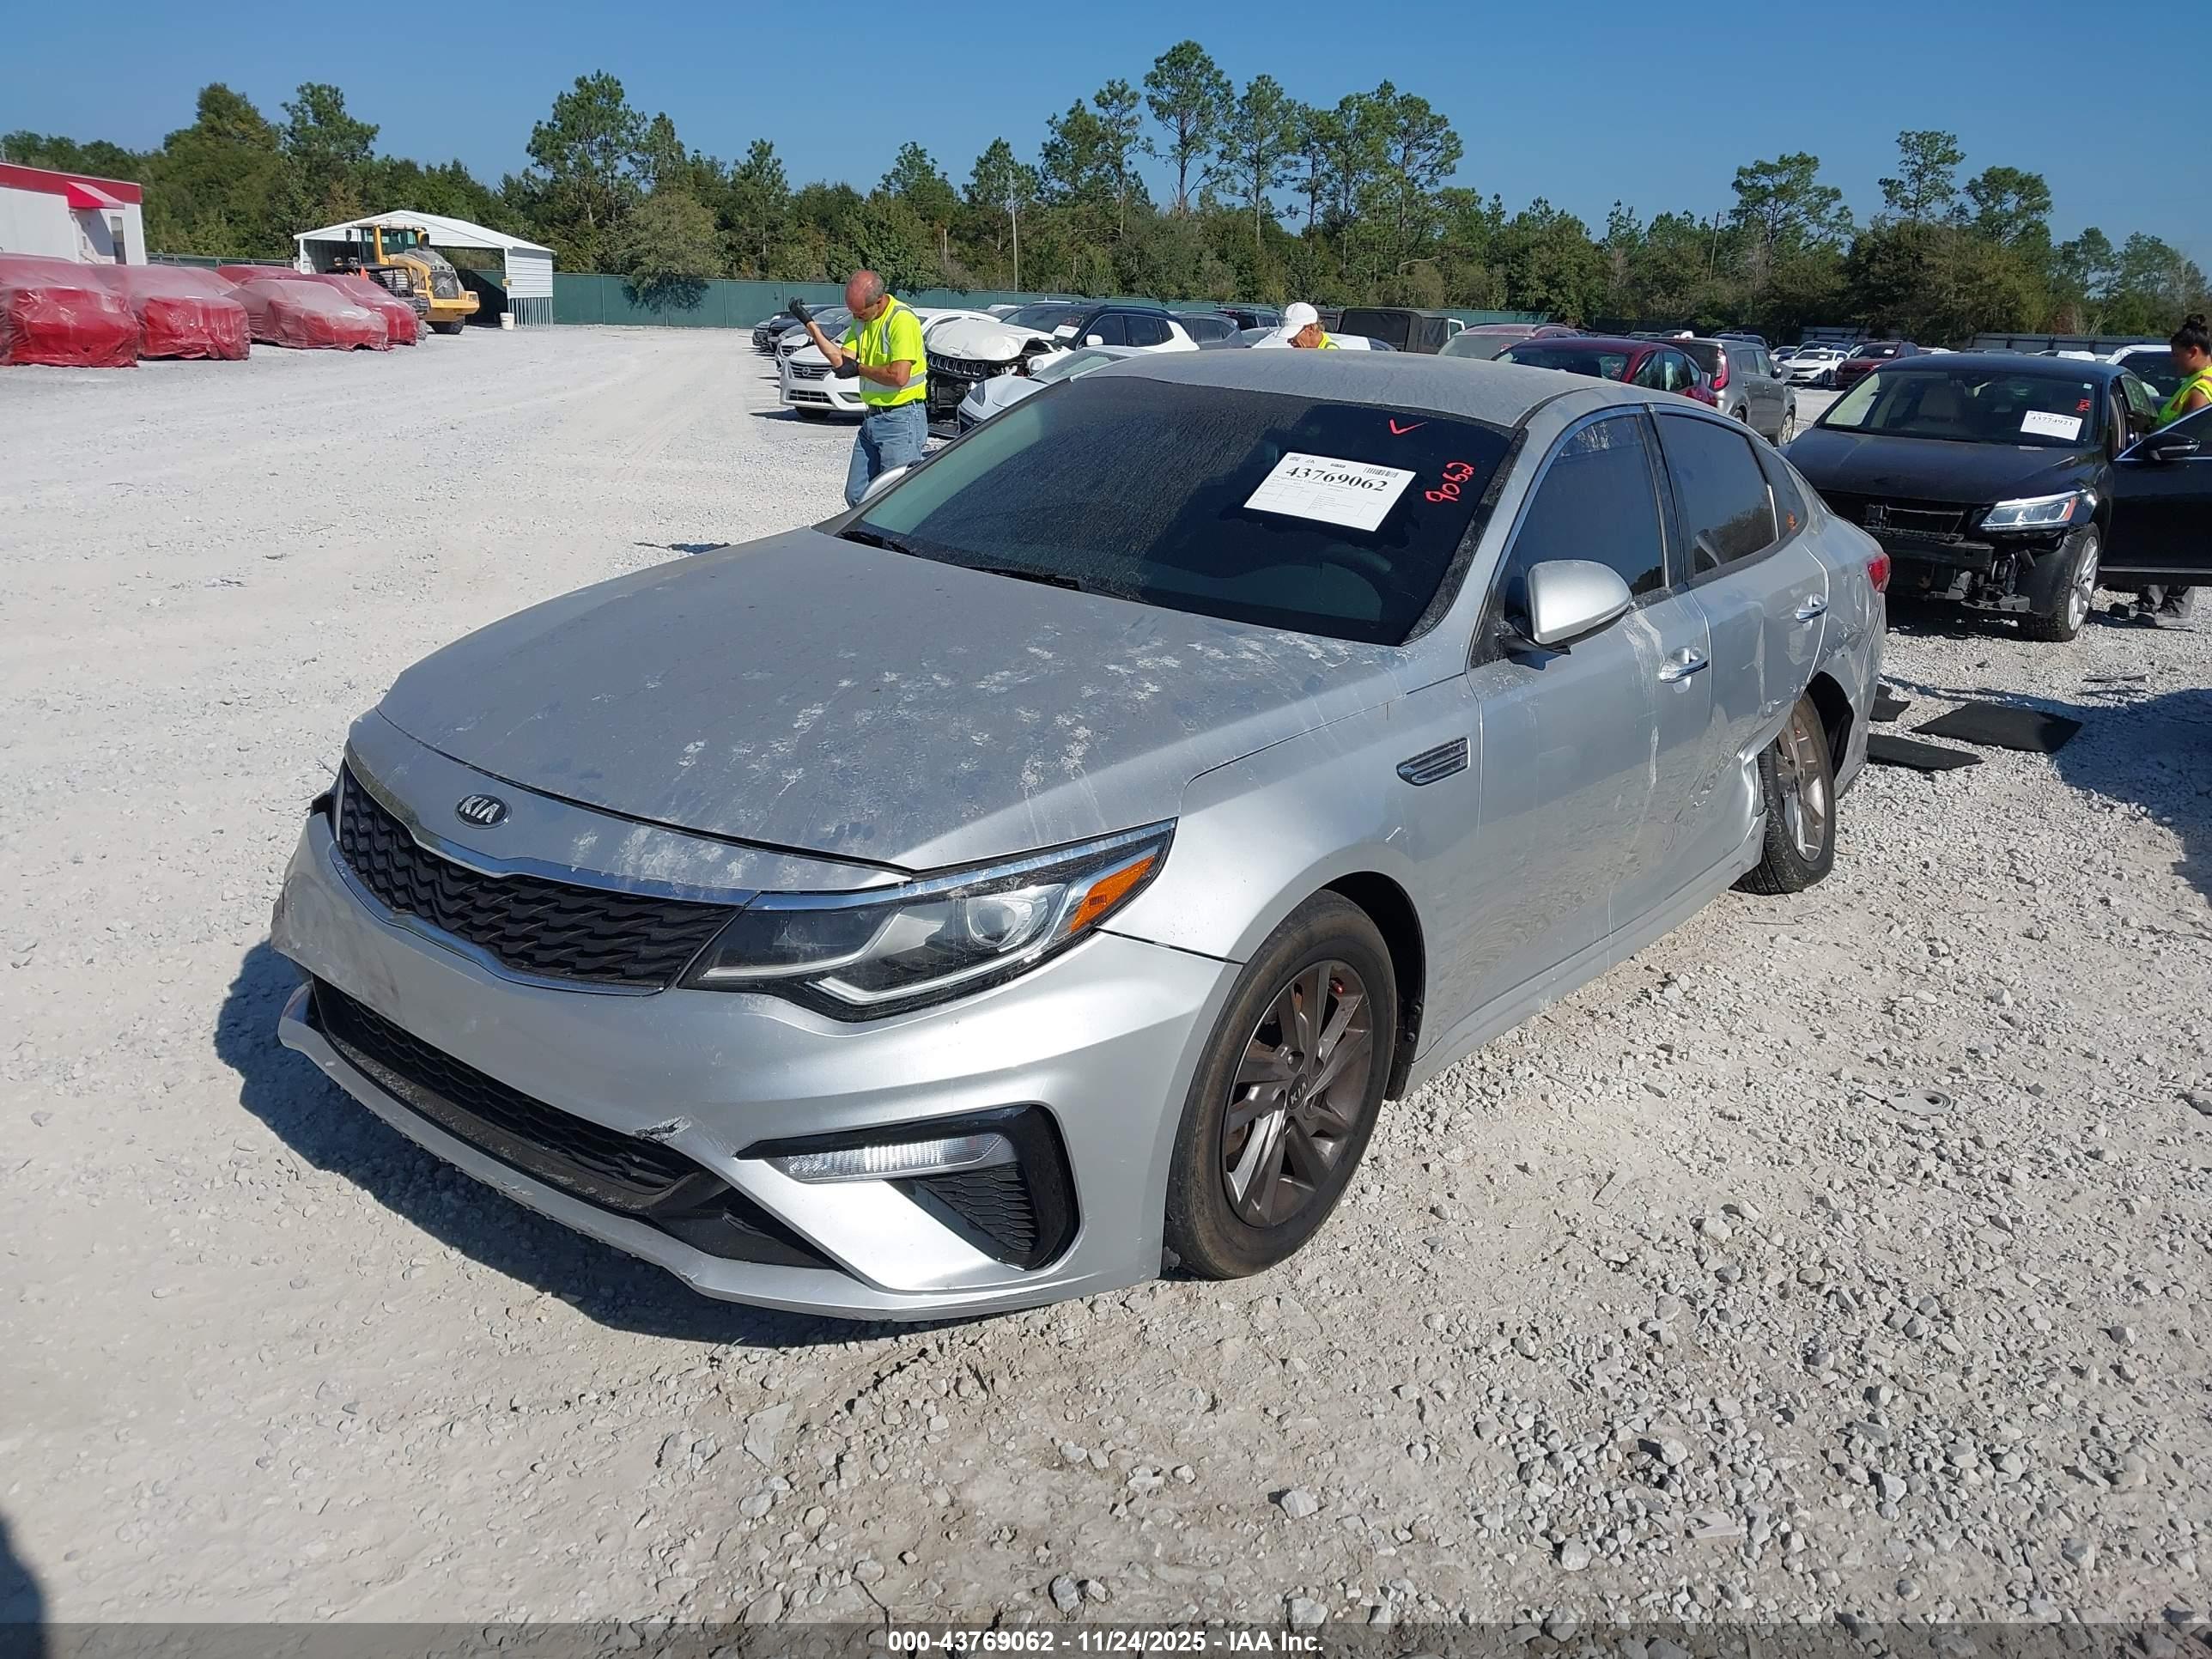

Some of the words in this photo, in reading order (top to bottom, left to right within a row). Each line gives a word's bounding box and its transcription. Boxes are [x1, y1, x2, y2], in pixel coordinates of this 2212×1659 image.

[1285, 466, 1389, 492] 43769062
[1425, 462, 1475, 502] 9062
[459, 796, 500, 823] KIA
[1290, 1082, 1307, 1104] KIA
